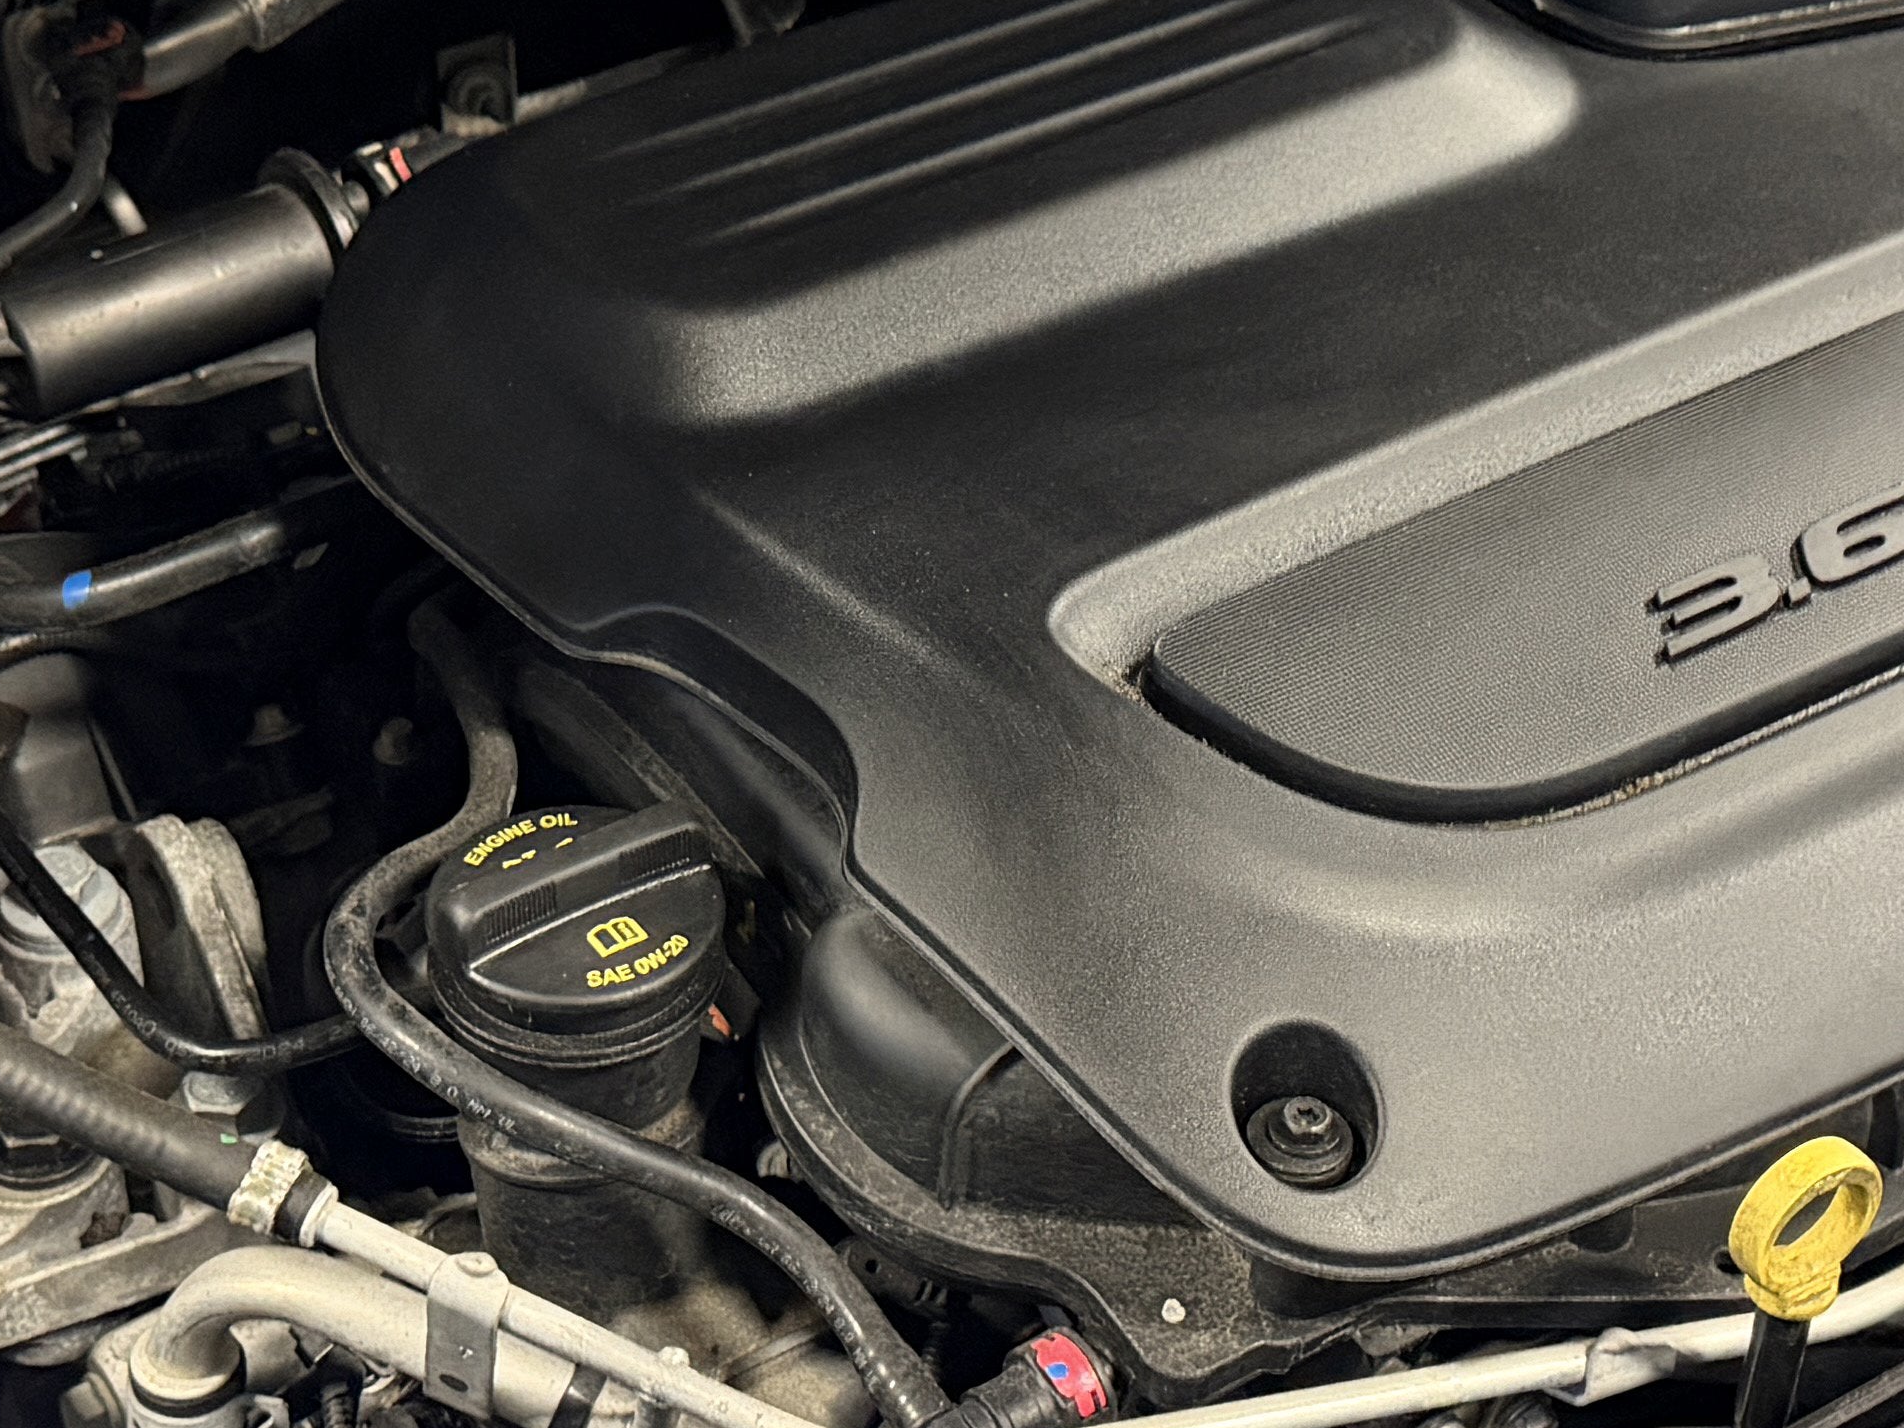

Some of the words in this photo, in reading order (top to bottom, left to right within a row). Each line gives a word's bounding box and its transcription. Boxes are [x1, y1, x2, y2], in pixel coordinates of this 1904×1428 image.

[463, 819, 536, 866] ENGINE
[539, 813, 578, 829] OIL
[586, 963, 636, 988] SAE
[634, 934, 689, 975] 0W-20
